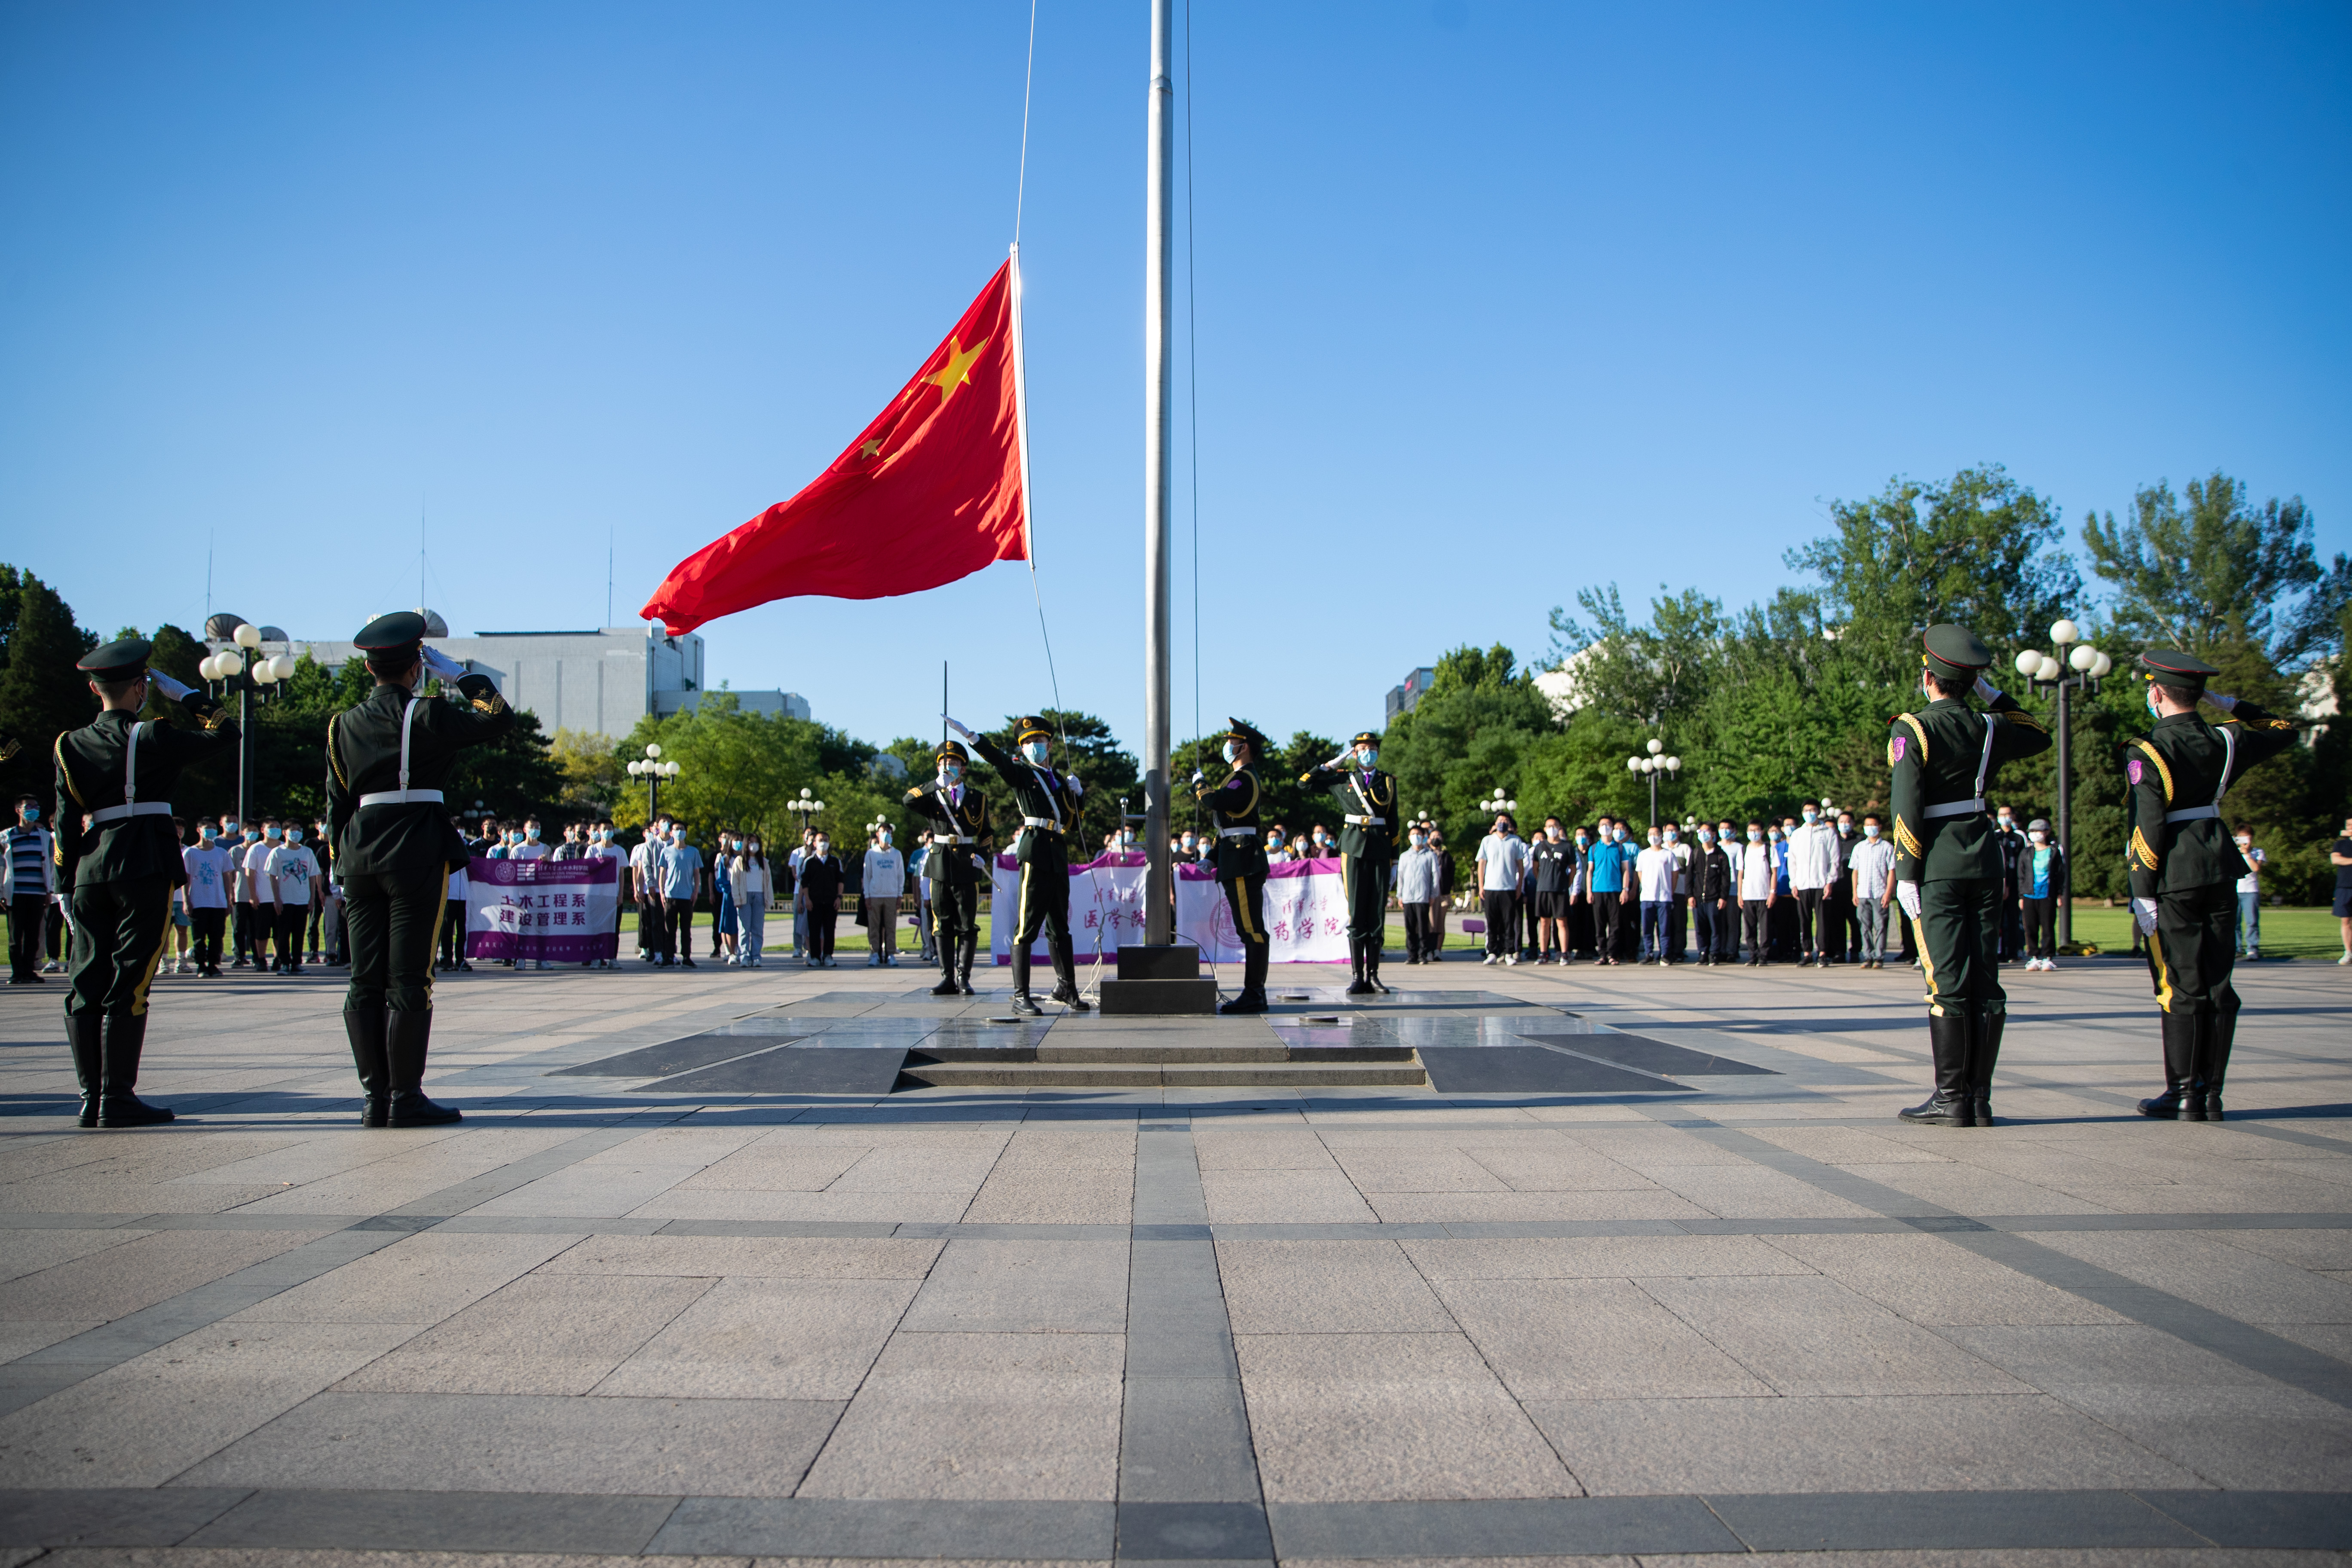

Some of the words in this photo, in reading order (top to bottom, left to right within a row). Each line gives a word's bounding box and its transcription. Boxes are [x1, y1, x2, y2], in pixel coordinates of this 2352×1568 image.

[501, 894, 585, 909] 土木工程系
[499, 909, 585, 926] 建设管理系
[1084, 907, 1146, 929] 医学院
[1273, 917, 1341, 940] 药学院
